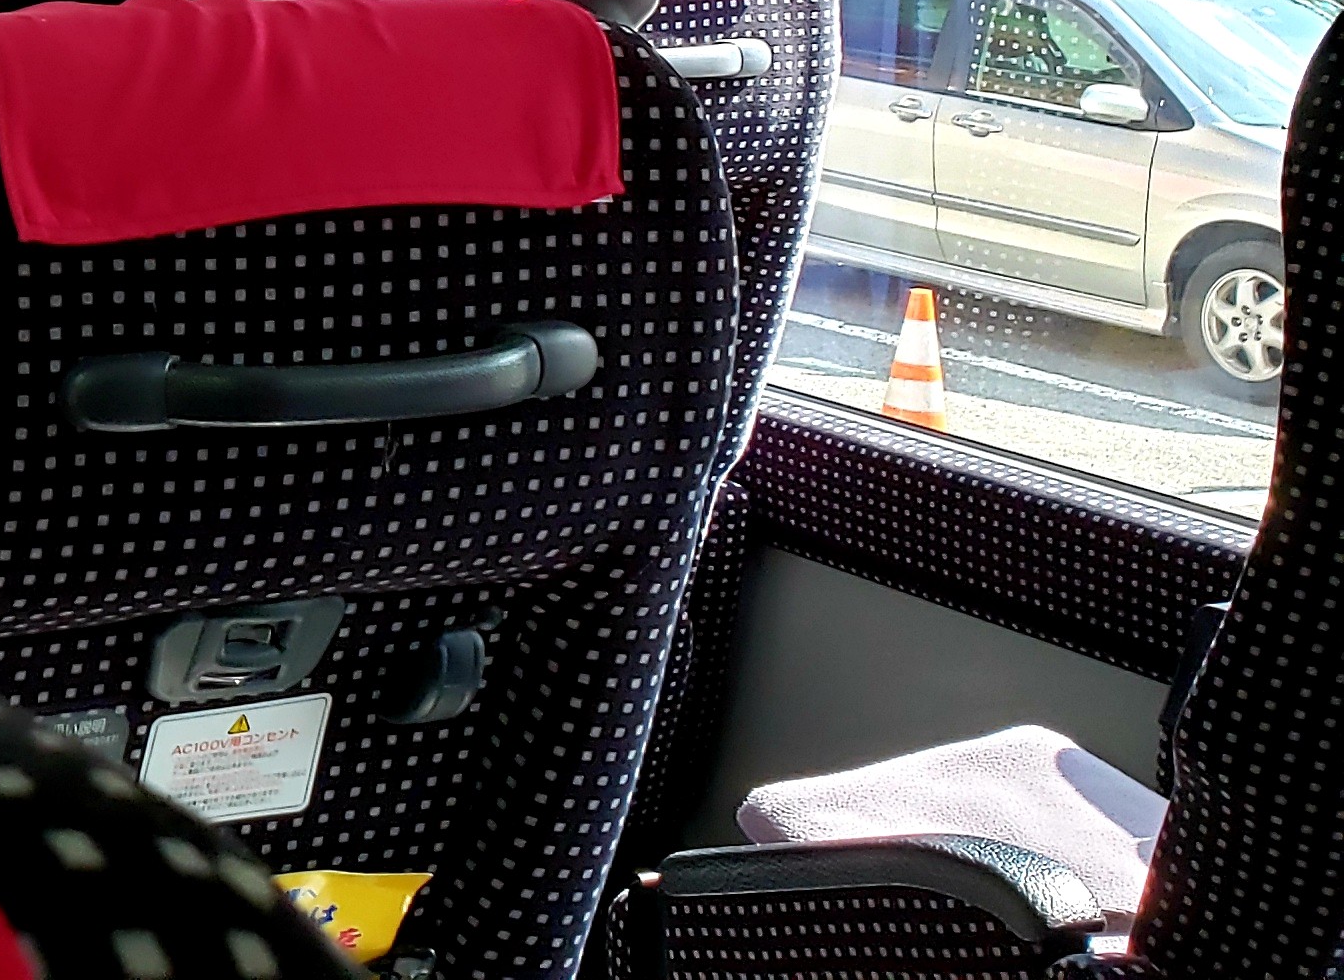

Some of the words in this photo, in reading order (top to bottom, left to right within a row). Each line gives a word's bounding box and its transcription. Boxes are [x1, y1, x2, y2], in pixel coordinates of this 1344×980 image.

[171, 727, 300, 756] AC100V用コンセント
